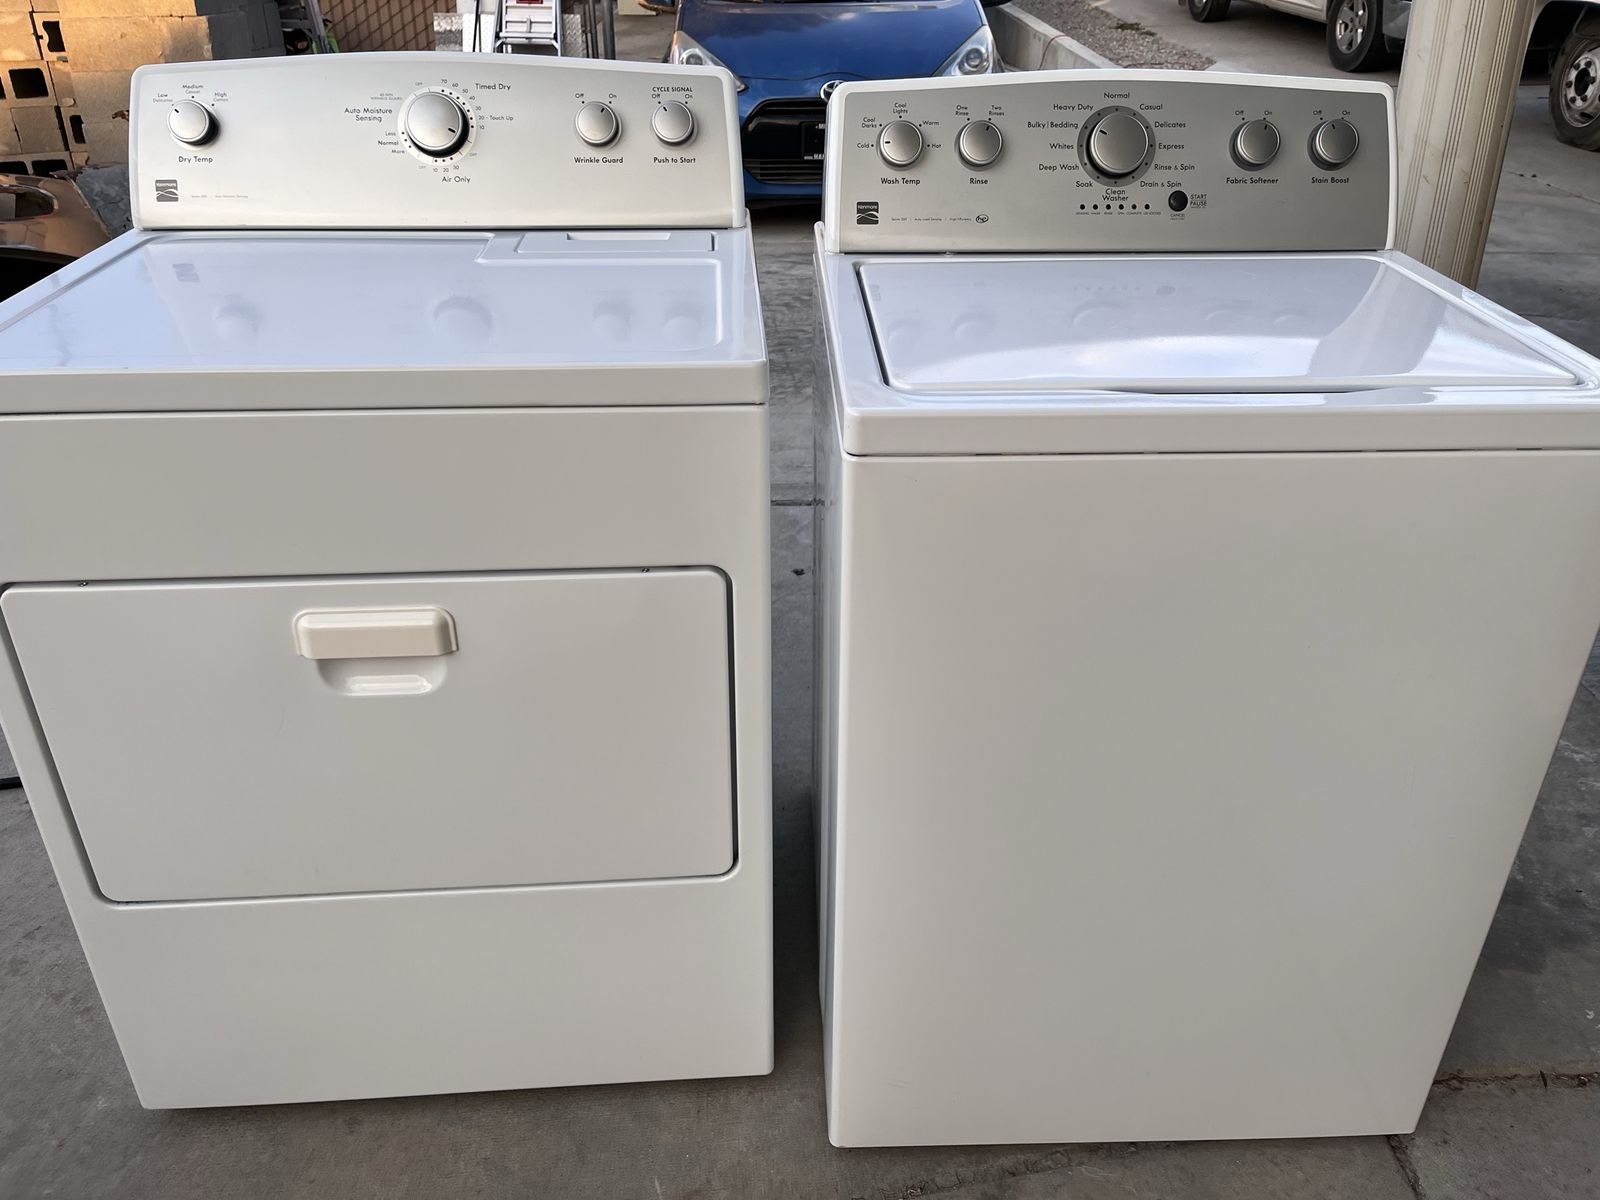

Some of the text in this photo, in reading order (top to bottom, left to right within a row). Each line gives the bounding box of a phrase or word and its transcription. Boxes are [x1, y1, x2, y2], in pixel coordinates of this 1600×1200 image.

[498, 83, 511, 91] Dry
[1053, 104, 1094, 112] Heavy Duty
[355, 115, 382, 123] Sensing
[1158, 143, 1185, 151] Express
[178, 156, 213, 164] Dry Temp
[1038, 164, 1057, 172] Deep
[1180, 164, 1195, 172] Spin
[454, 175, 471, 184] Only
[901, 178, 921, 186] Temp
[1226, 177, 1279, 185] Fabric Softener
[1166, 181, 1182, 189] Spin
